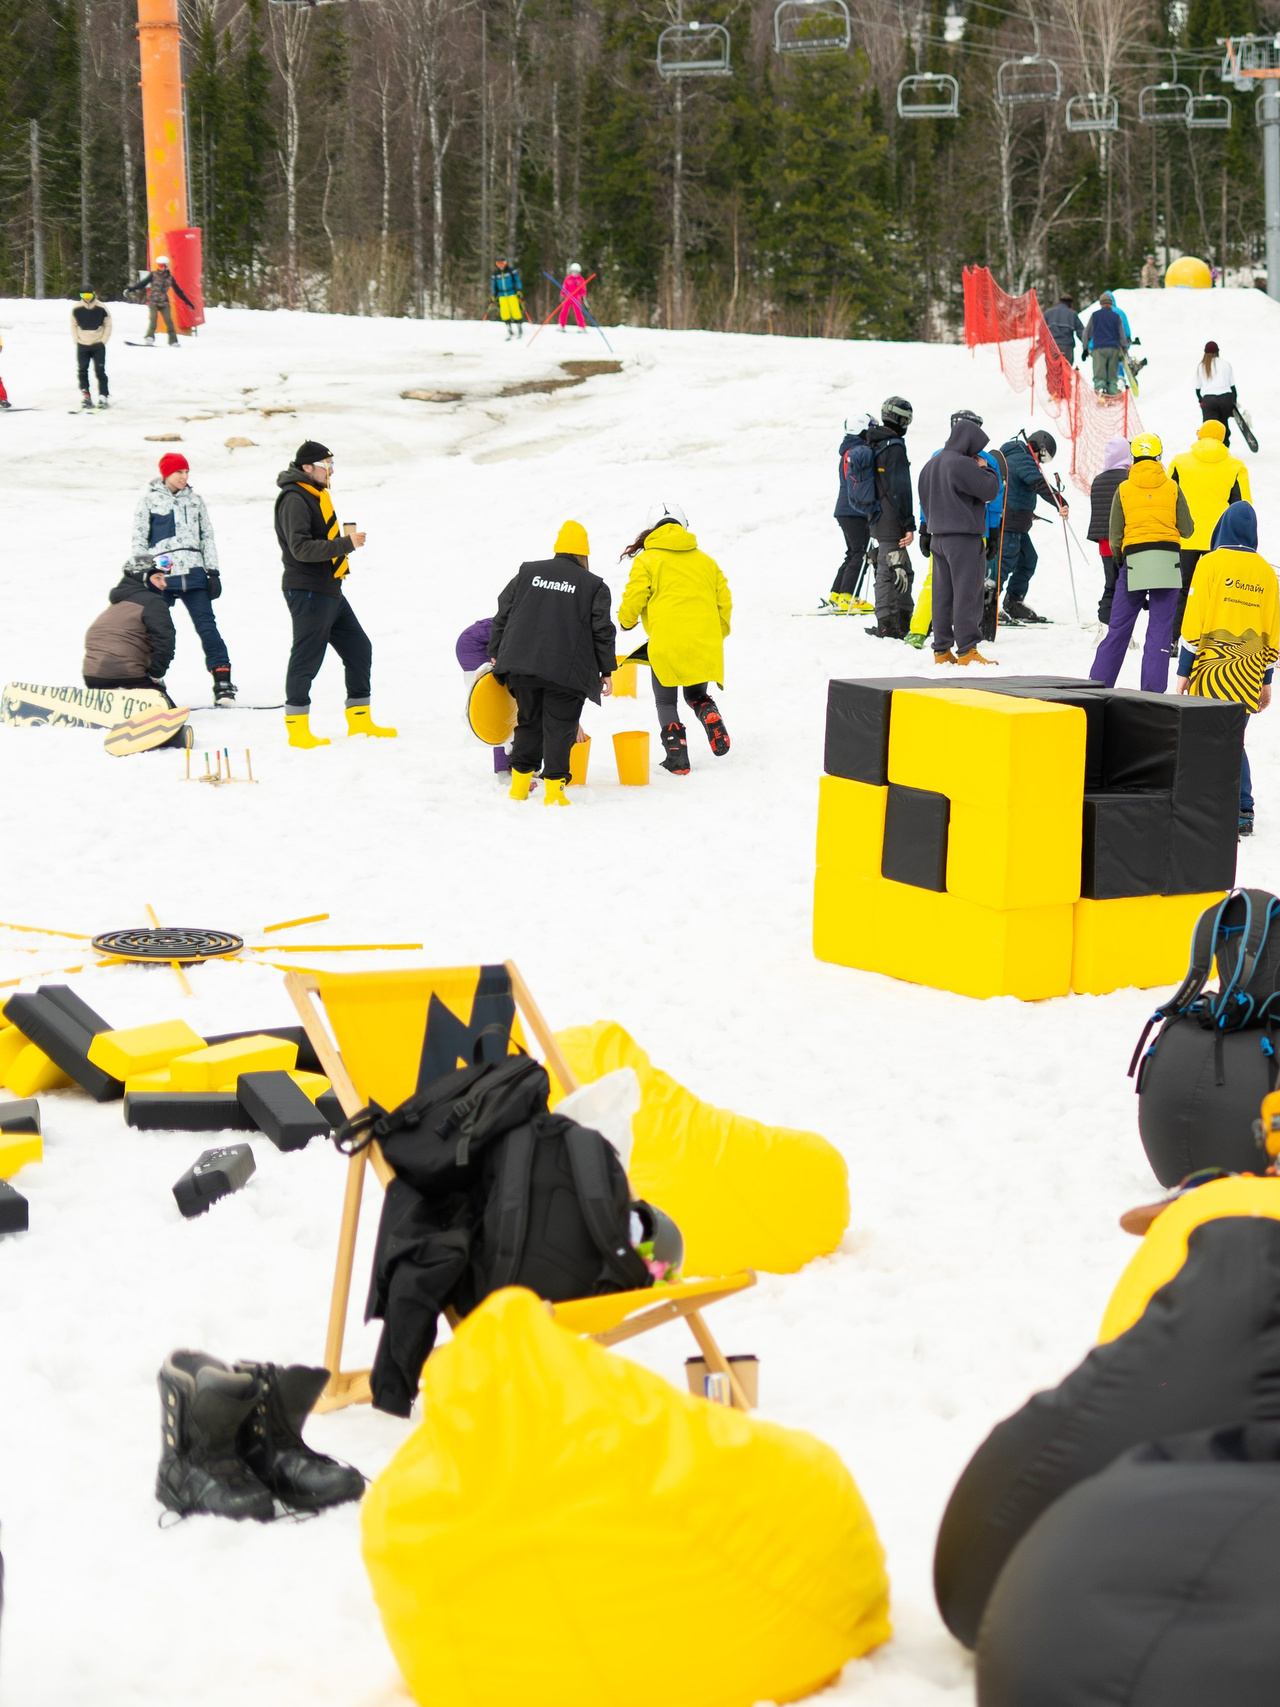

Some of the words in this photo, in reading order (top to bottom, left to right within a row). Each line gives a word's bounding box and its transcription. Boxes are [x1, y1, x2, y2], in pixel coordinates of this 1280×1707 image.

[531, 575, 576, 594] билайн
[1235, 579, 1265, 594] билайн
[11, 682, 114, 714] SNOWBO
